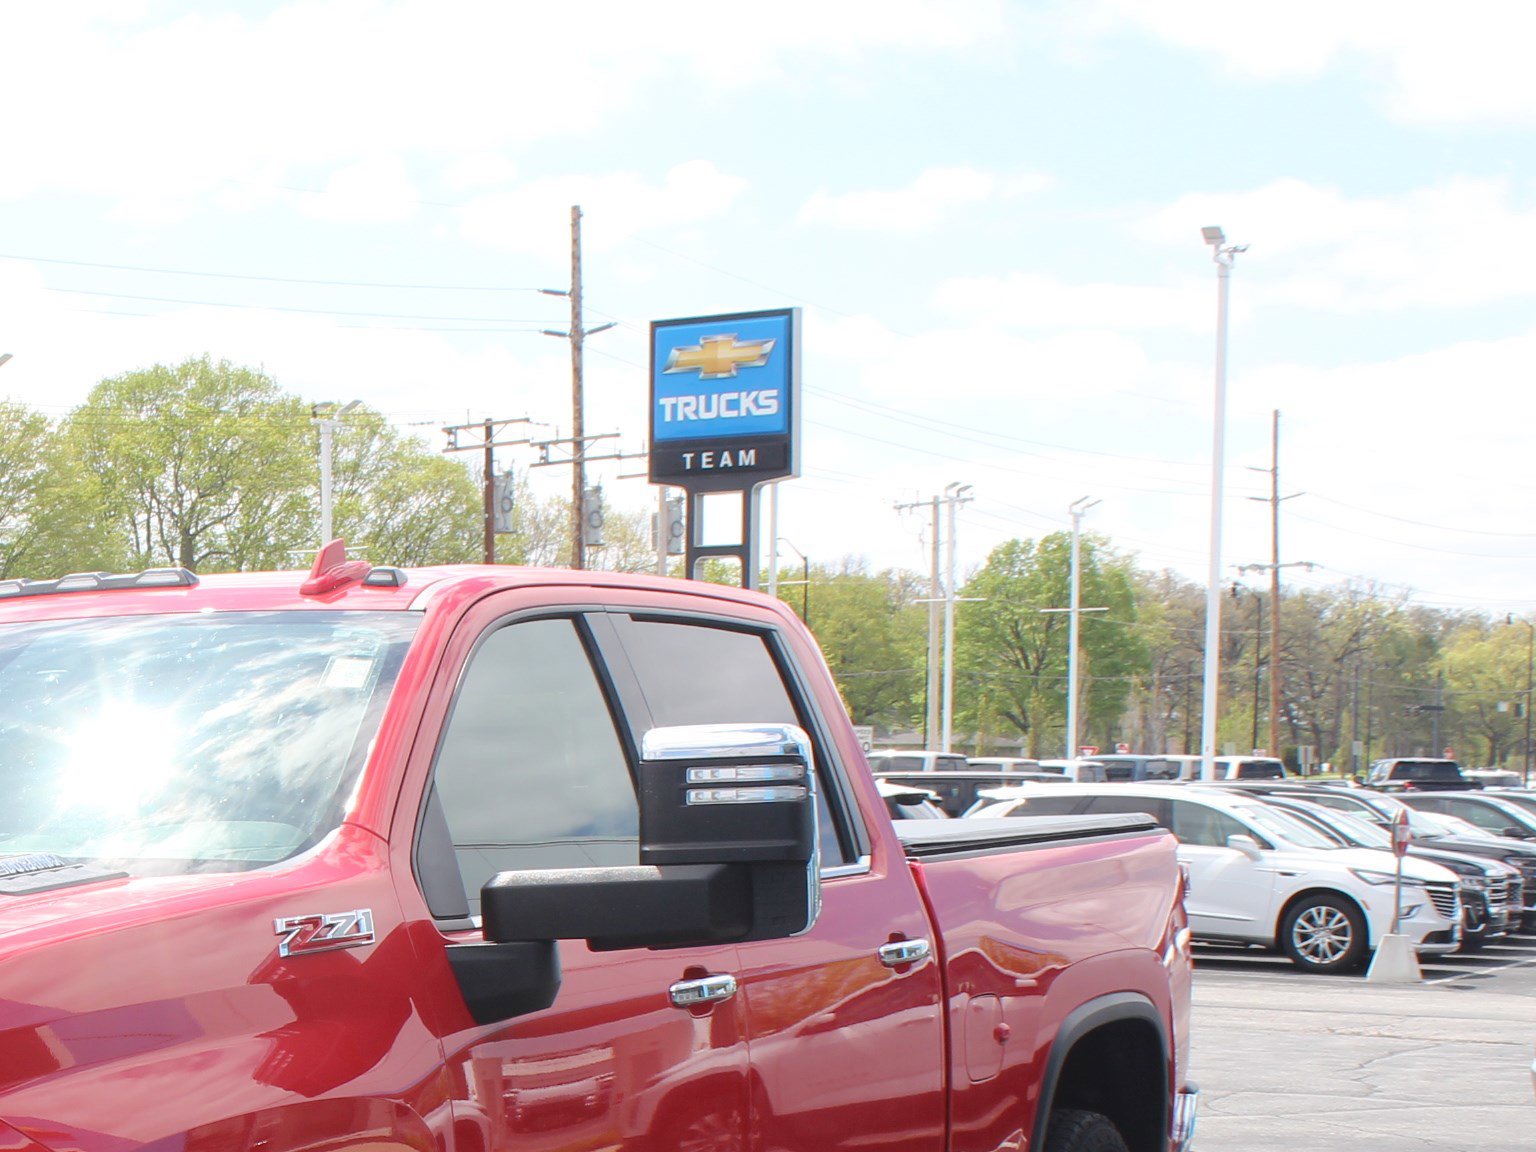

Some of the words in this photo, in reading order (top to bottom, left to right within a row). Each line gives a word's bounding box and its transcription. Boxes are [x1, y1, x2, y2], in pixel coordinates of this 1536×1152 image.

[659, 389, 779, 423] TRUCKS
[682, 449, 756, 470] TEAM
[273, 907, 376, 958] Z71
